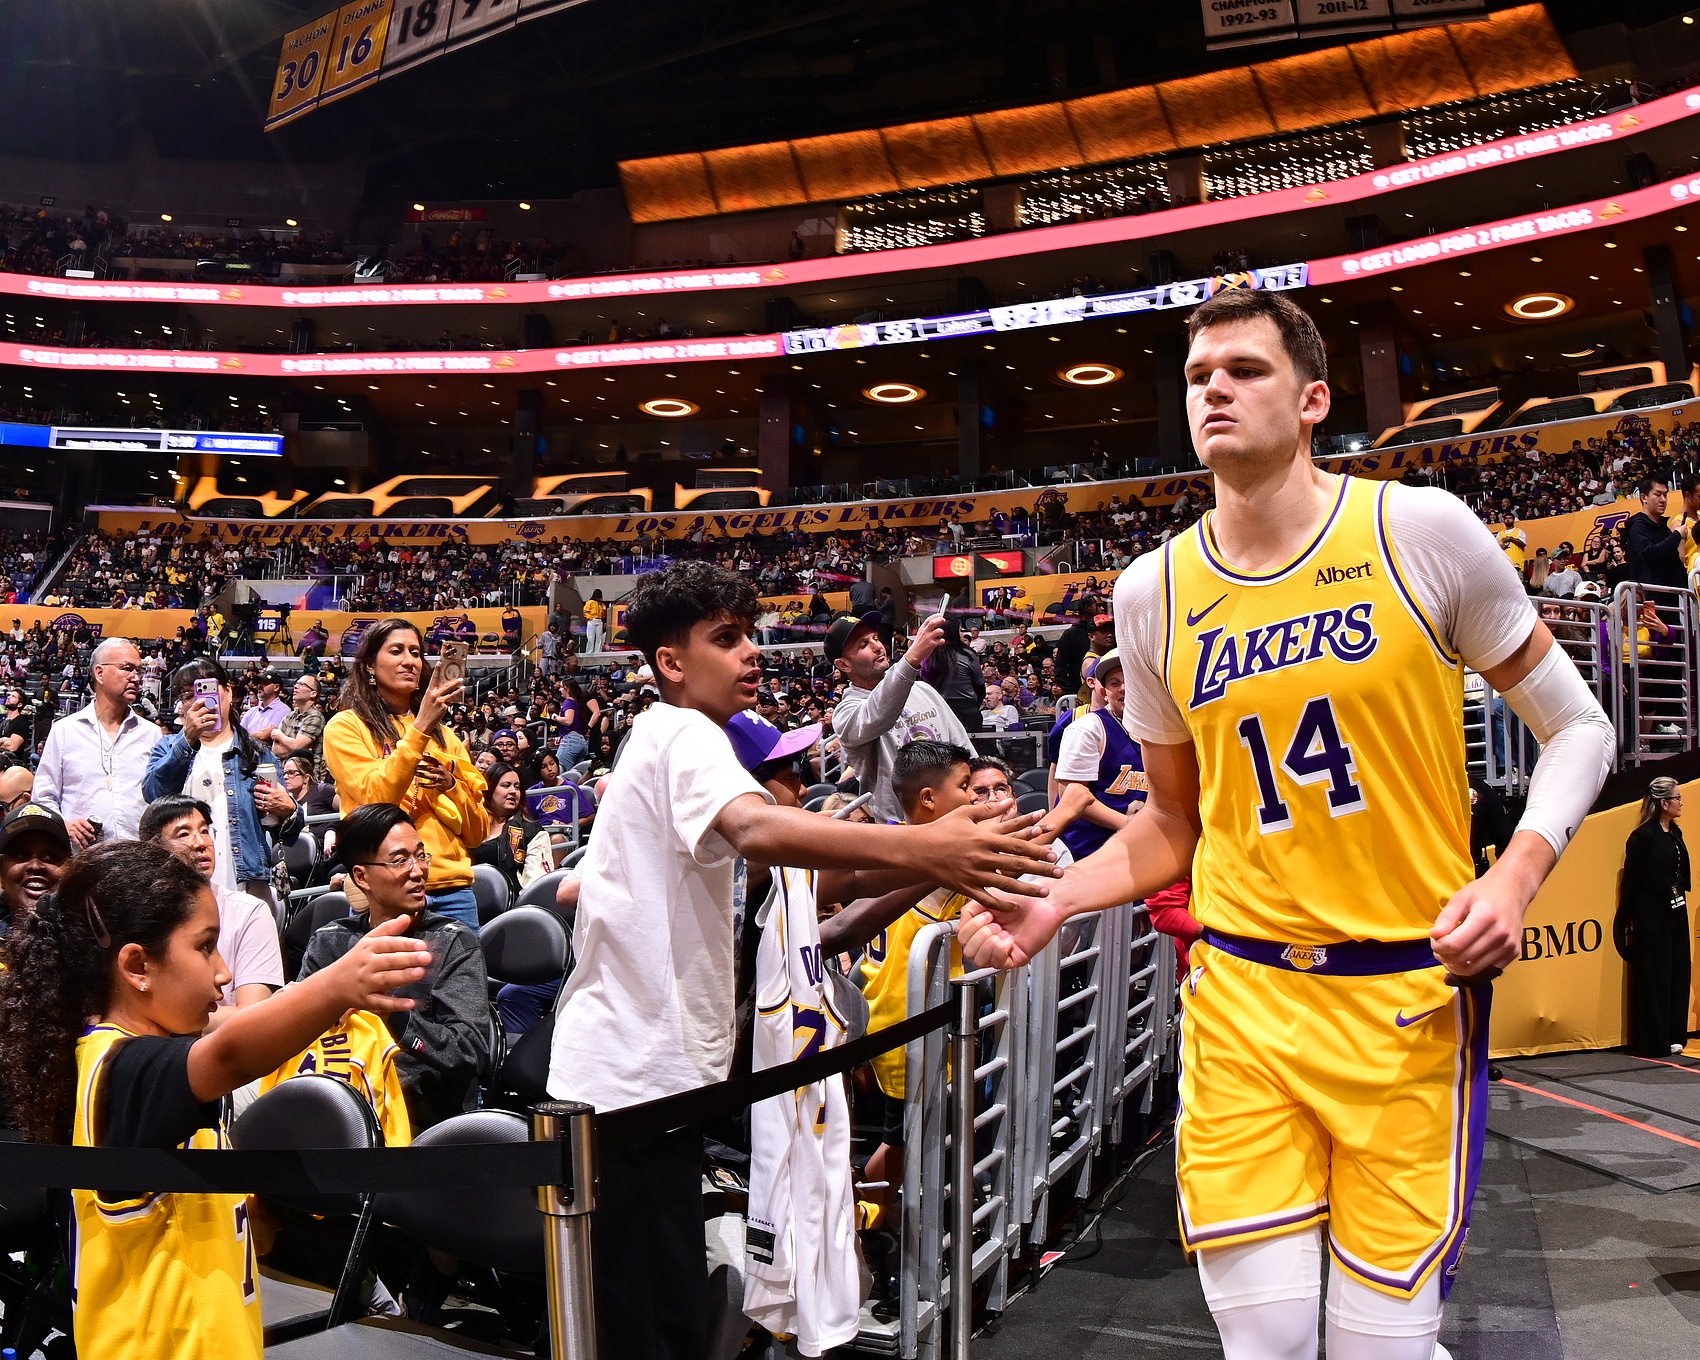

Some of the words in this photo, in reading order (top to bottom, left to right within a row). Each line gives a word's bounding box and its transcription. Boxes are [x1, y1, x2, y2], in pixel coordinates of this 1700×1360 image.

[343, 0, 386, 25] DIONNE
[1211, 0, 1281, 11] CHAMPIO
[1221, 8, 1277, 27] 1992-93
[1317, 0, 1368, 14] 2011-12
[398, 0, 438, 44] 18
[288, 25, 329, 51] VACHON
[336, 24, 373, 72] 16
[276, 51, 319, 101] 30
[1390, 167, 1421, 186] GET
[1421, 156, 1467, 178] LOUD
[1467, 148, 1503, 168] FOR
[1516, 135, 1559, 156] FREE
[1558, 123, 1613, 146] TACOS
[1360, 252, 1394, 271] GET
[1393, 242, 1440, 264] LOUD
[1440, 233, 1479, 253] FOR
[1491, 220, 1537, 242] FREE
[1536, 208, 1593, 232] TACOS
[1388, 430, 1540, 469] LAKERS
[1140, 475, 1209, 498] LOS
[138, 521, 194, 537] LOS
[205, 522, 335, 538] ANGELES
[346, 523, 469, 538] LAKERS
[615, 516, 677, 533] LOS
[683, 509, 831, 531] ANGELES
[838, 498, 977, 523] LAKERS
[1314, 561, 1373, 587] Albert
[257, 618, 276, 630] 115
[1188, 601, 1380, 711] LAKERS
[1235, 694, 1367, 835] 14
[1280, 943, 1328, 966] LAKERS
[1518, 918, 1603, 962] BMO
